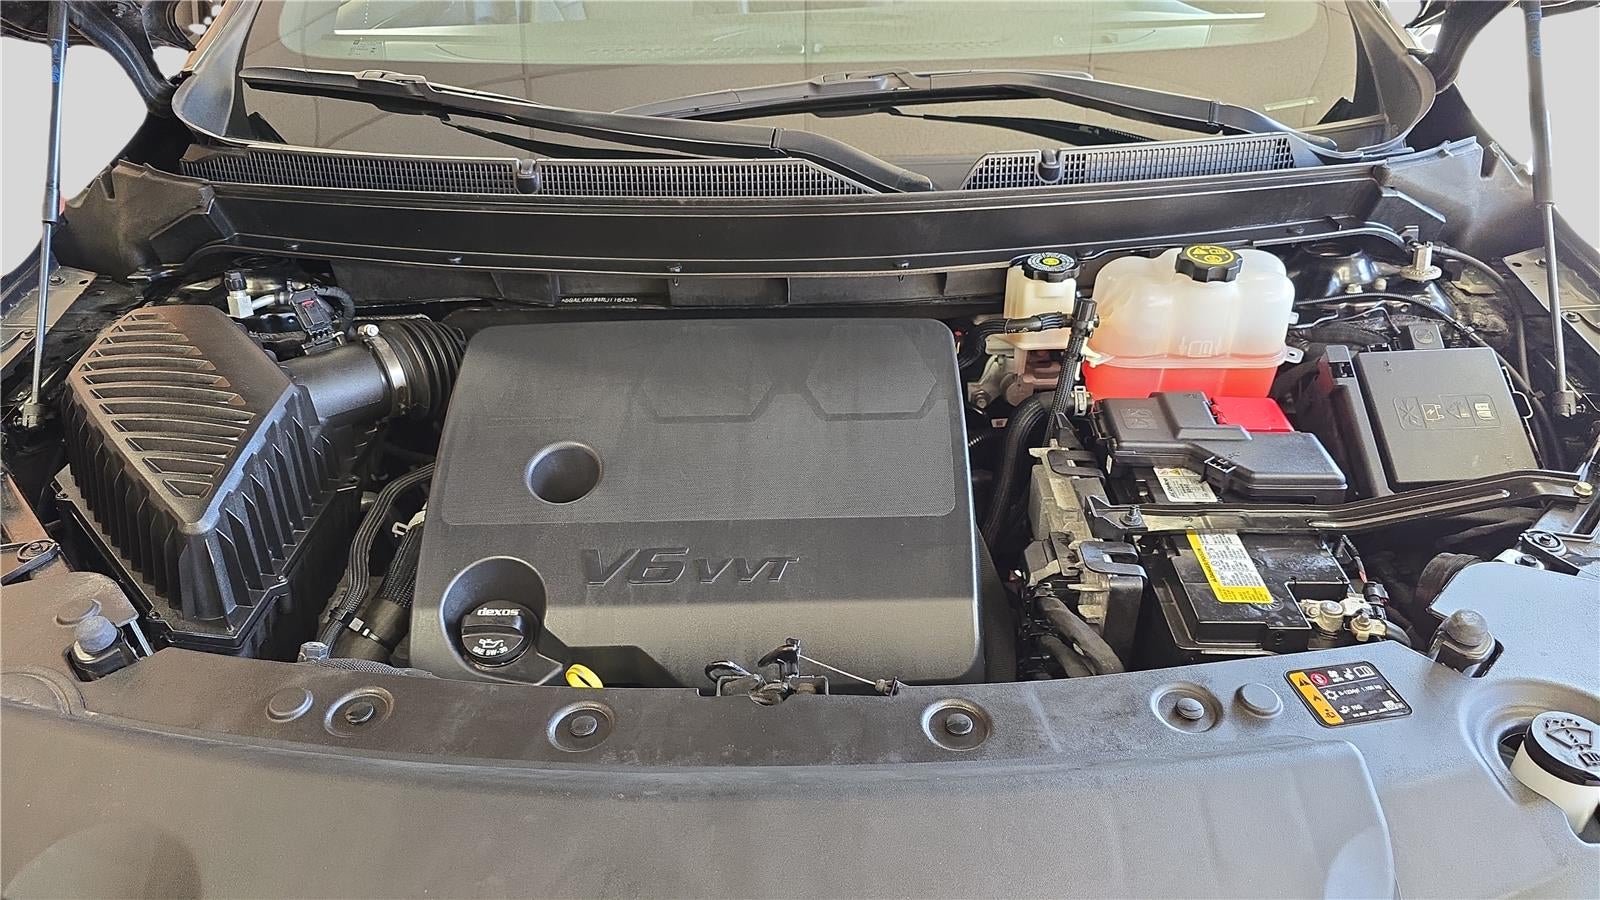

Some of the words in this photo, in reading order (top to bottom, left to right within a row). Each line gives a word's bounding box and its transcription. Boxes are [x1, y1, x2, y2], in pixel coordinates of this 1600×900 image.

[583, 548, 690, 585] V6
[696, 556, 800, 583] VVT
[477, 607, 521, 616] dexos
[472, 646, 486, 656] SAE
[485, 646, 509, 656] 5W-30
